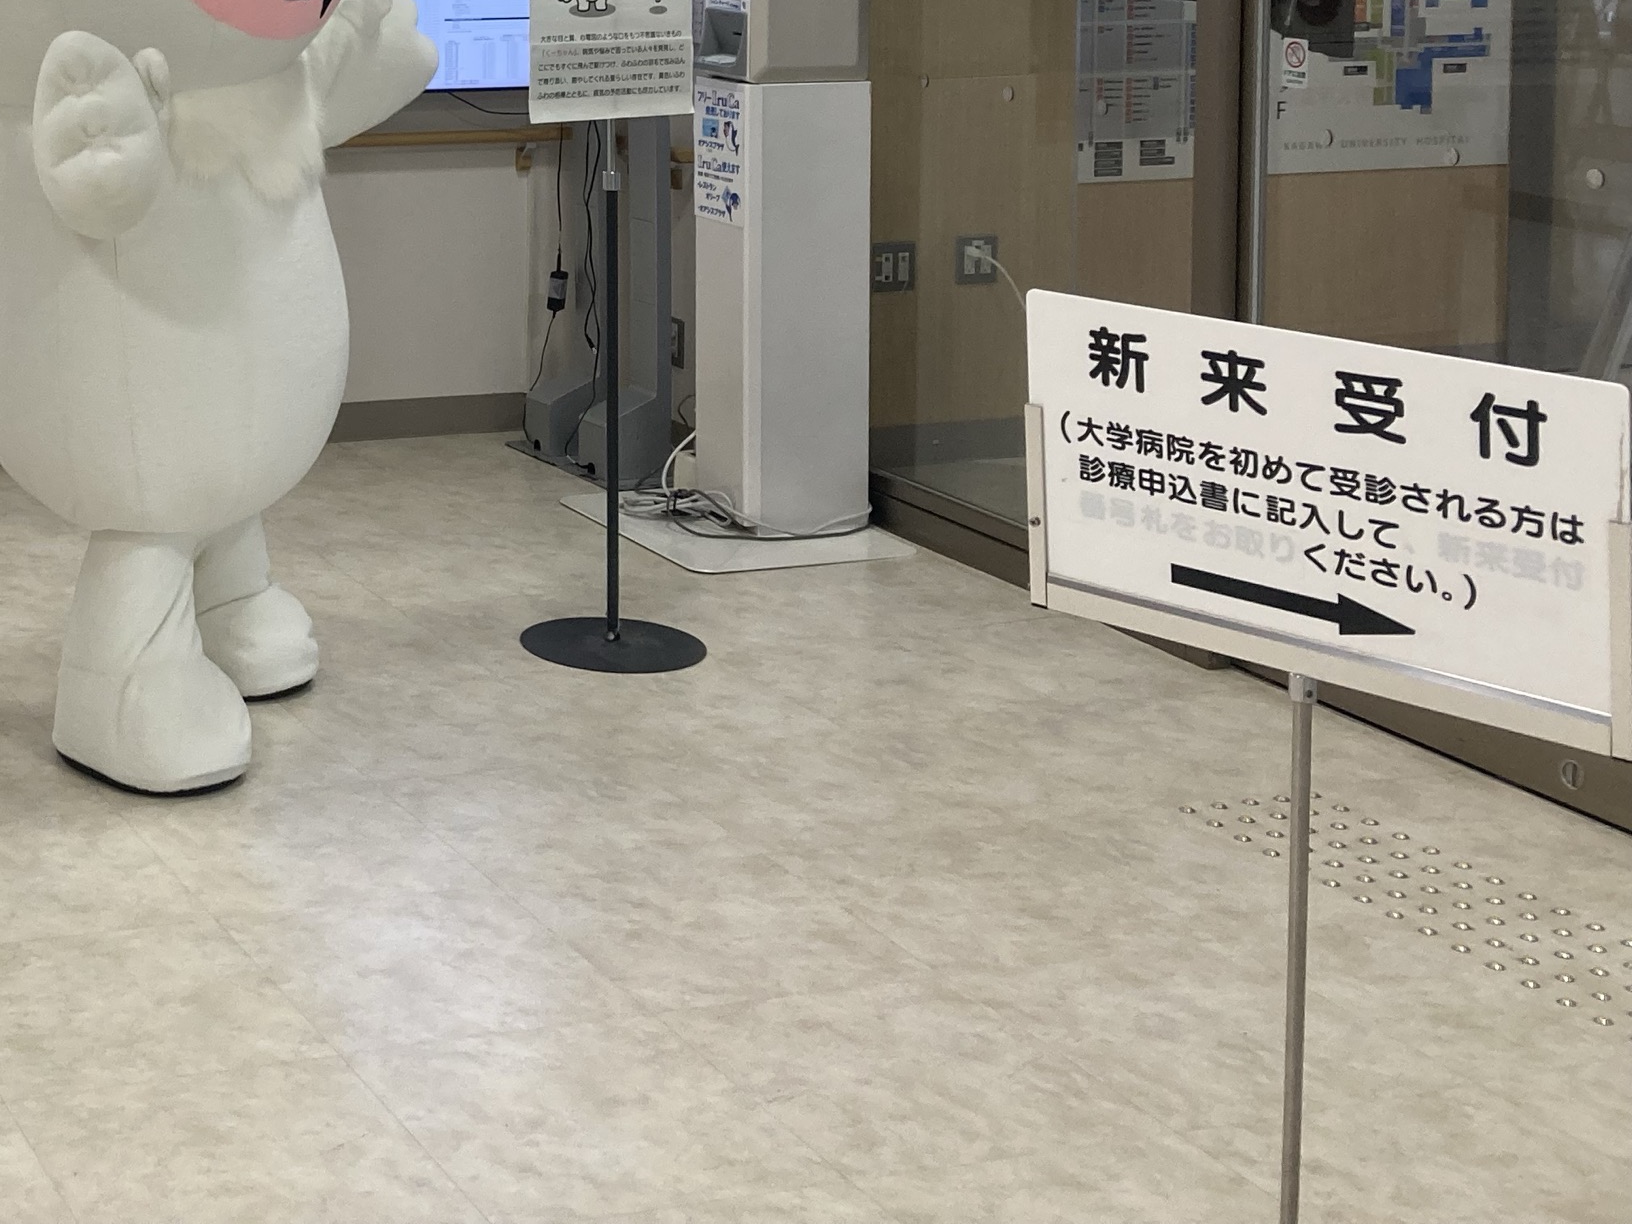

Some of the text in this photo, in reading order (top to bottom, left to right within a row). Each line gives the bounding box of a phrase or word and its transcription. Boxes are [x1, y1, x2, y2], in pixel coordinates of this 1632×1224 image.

[1283, 140, 1330, 150] KAGAW
[1088, 325, 1548, 467] 新来受付
[1078, 454, 1400, 549] 診療申込書に記入して
